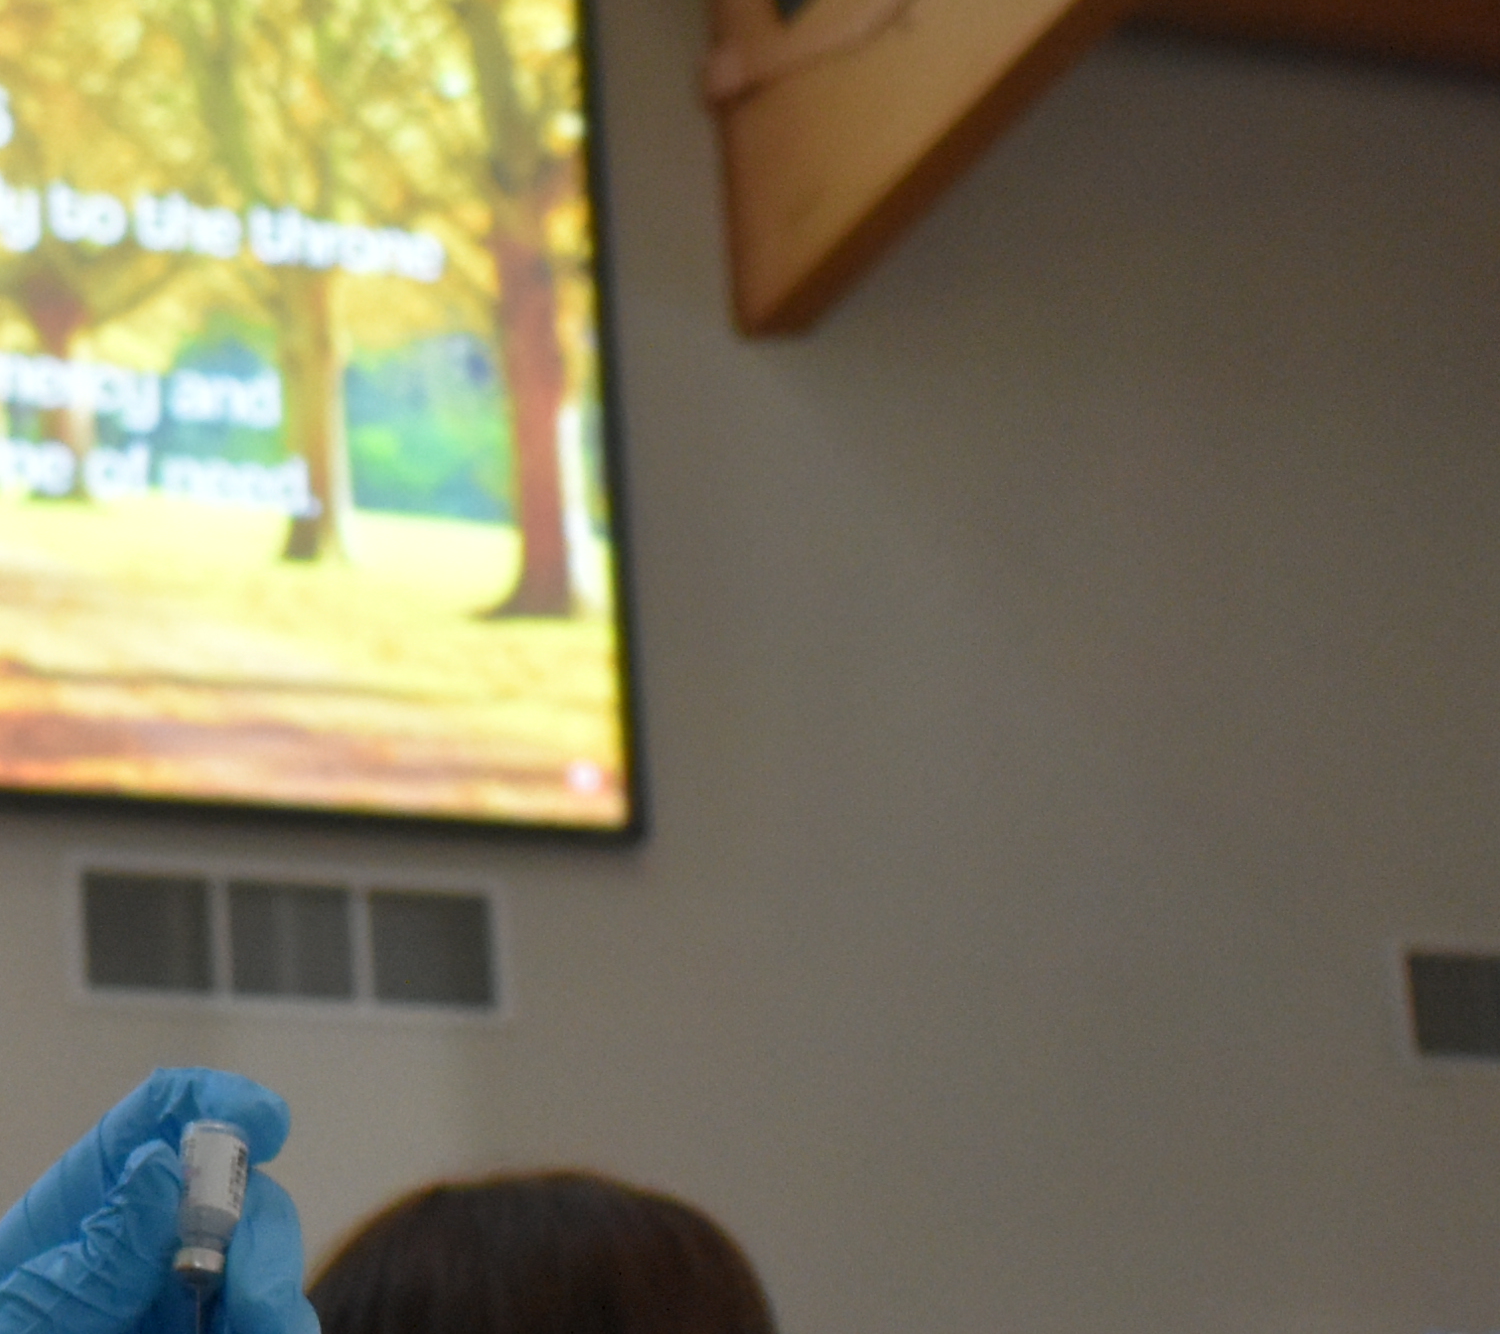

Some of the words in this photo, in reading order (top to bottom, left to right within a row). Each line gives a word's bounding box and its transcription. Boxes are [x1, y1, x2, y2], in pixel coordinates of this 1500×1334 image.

[46, 178, 128, 247] to
[133, 189, 243, 260] the
[247, 203, 446, 284] throne
[168, 367, 282, 429] and
[84, 442, 150, 500] of
